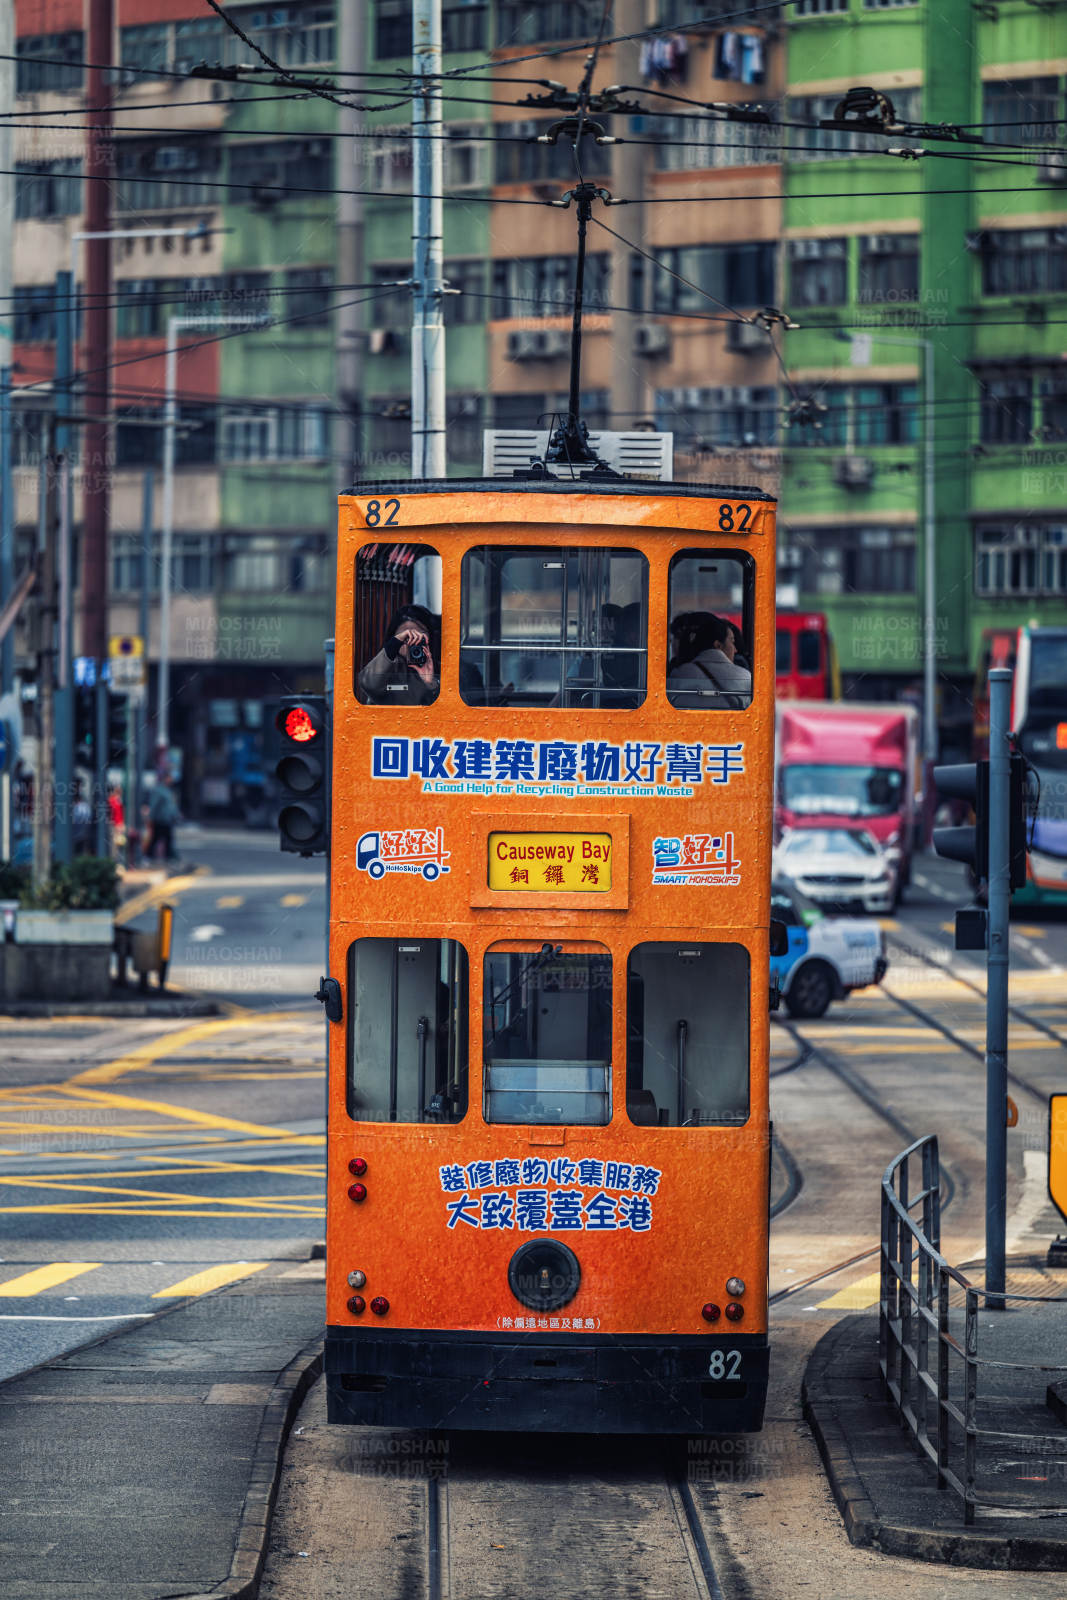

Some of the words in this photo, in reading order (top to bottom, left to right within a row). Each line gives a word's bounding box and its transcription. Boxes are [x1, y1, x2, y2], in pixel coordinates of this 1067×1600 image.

[365, 499, 400, 527] 82
[719, 503, 752, 532] 82
[372, 737, 744, 783] 回收建築廢物好幫手
[423, 782, 432, 793] A
[434, 782, 464, 793] Good
[466, 783, 493, 795] Help
[495, 783, 514, 794] for
[516, 784, 574, 797] Recycling
[576, 784, 654, 797] Construction
[496, 841, 575, 863] Causeway
[582, 840, 611, 863] Bay
[508, 863, 600, 886] 銅鑼灣
[653, 875, 688, 884] SMART
[688, 875, 740, 884] HOHOSKIPS
[440, 1157, 662, 1195] 裝修廢物收集服務
[446, 1189, 652, 1232] 大致覆蓋全港
[708, 1349, 742, 1380] 82
